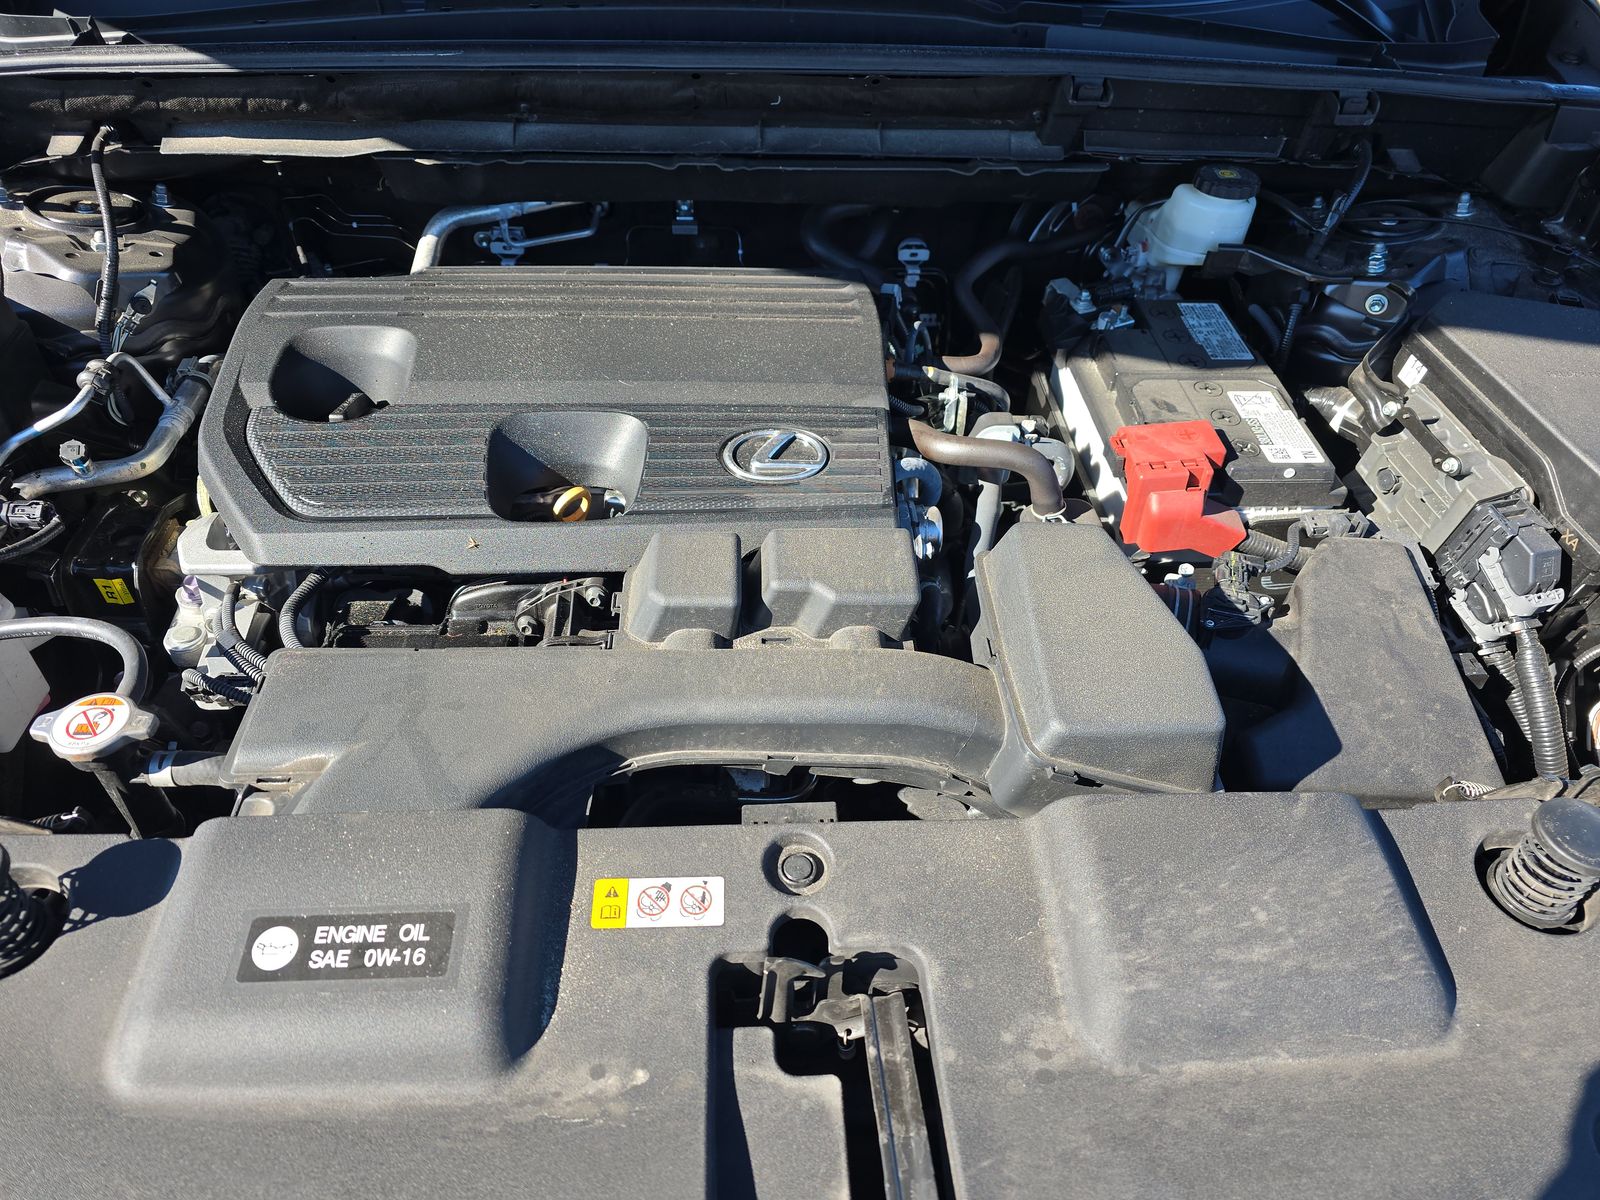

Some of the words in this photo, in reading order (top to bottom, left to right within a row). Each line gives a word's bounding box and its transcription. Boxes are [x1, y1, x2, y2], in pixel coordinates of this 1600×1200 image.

[314, 924, 387, 944] ENGINE
[399, 923, 430, 942] OIL
[308, 949, 351, 969] SAE
[363, 947, 427, 967] 0W-16
